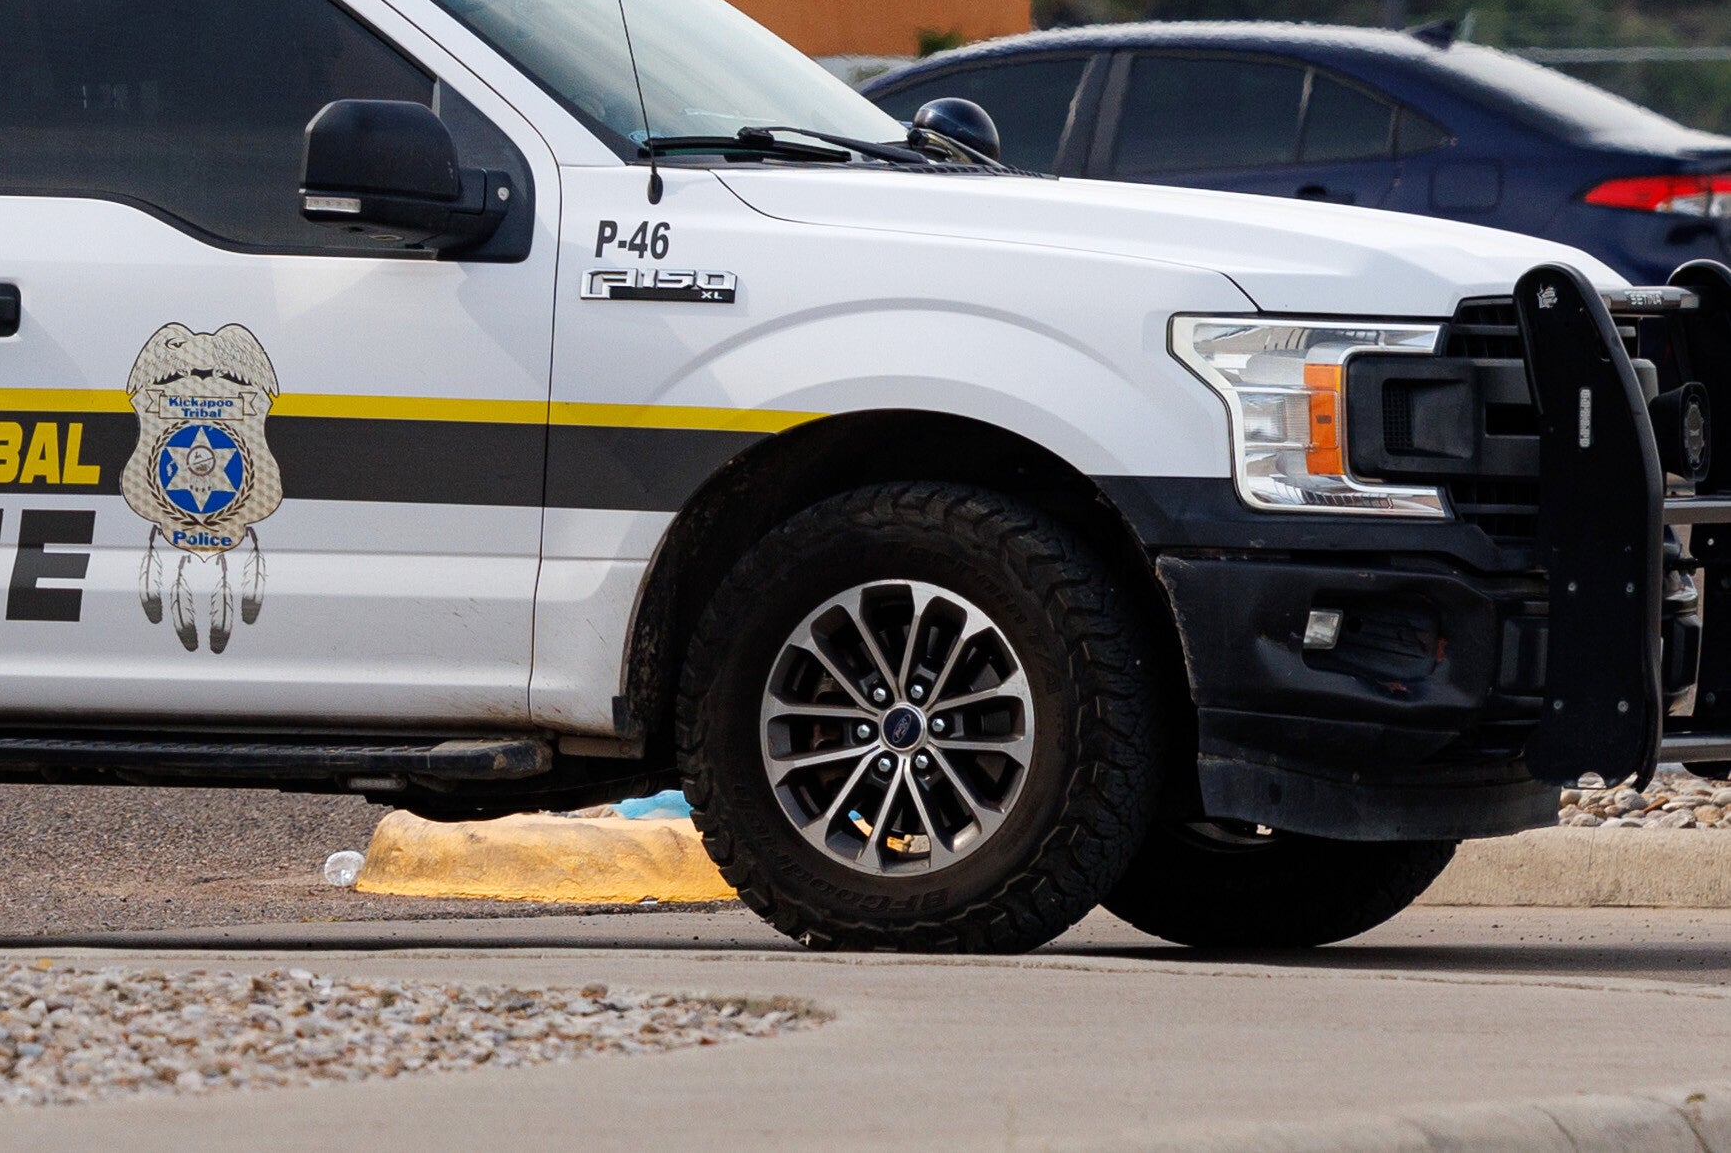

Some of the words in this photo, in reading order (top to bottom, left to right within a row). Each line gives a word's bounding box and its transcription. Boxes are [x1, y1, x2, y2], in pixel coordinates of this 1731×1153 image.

[594, 220, 671, 260] P-46
[700, 290, 724, 300] XL
[168, 396, 234, 408] Kickapoo
[181, 407, 222, 419] Tribal
[172, 530, 233, 547] Police
